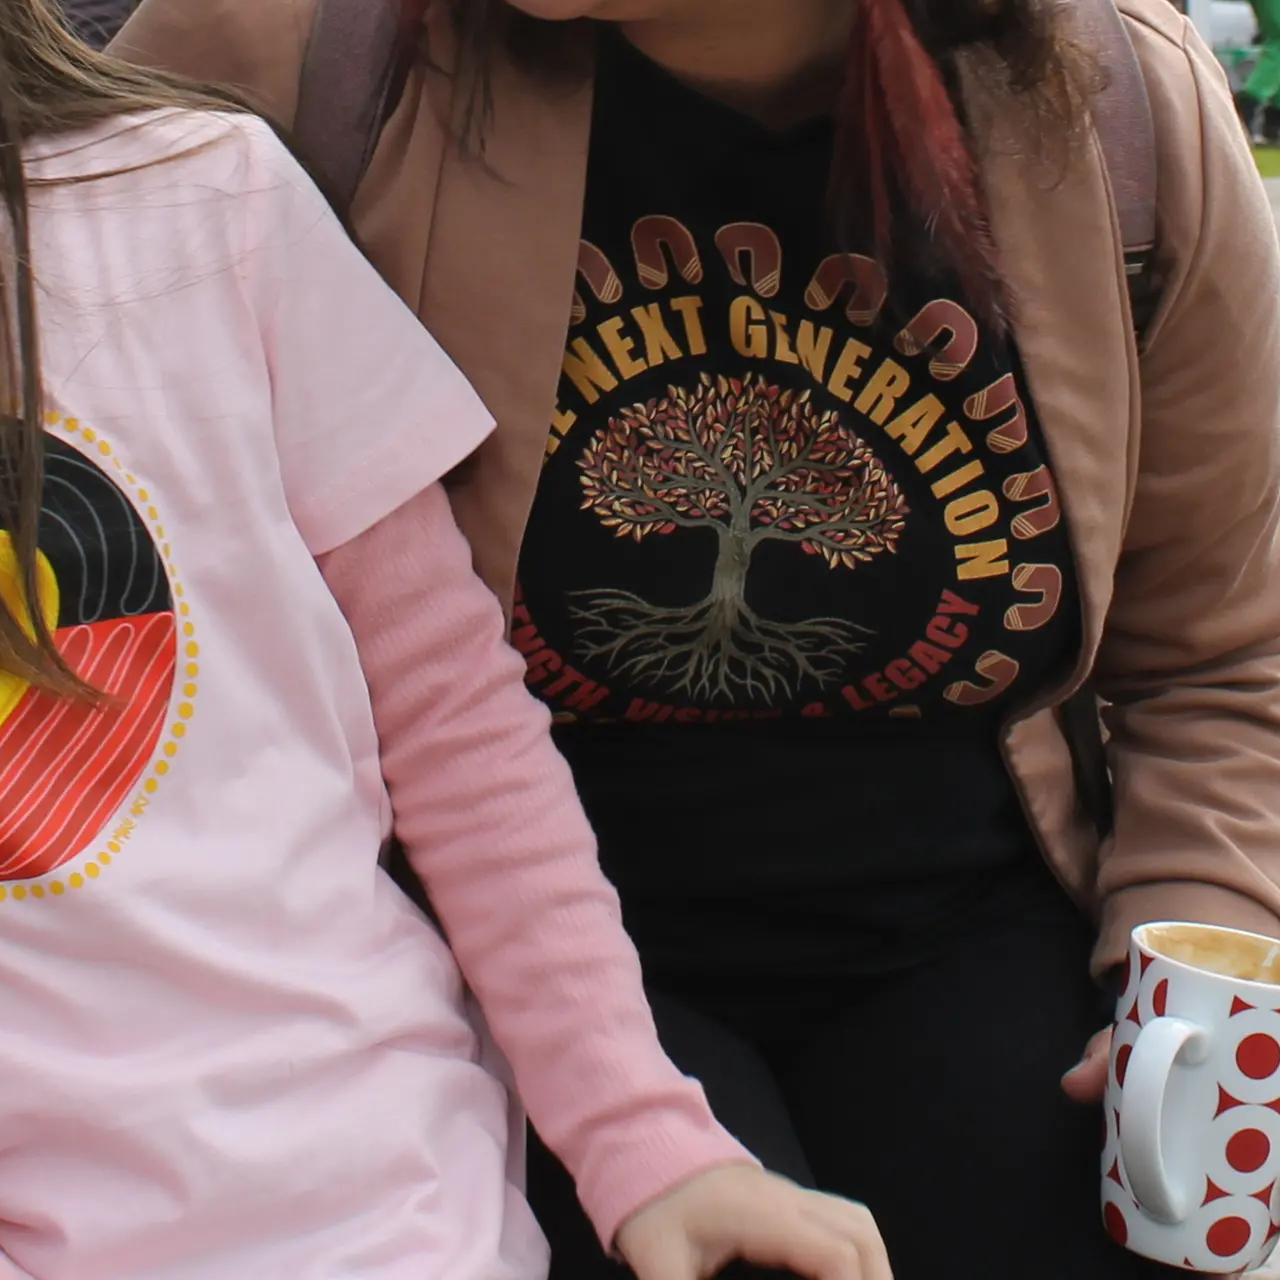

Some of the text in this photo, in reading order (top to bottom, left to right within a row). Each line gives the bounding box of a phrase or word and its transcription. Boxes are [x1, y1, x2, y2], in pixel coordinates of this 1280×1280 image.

[562, 295, 1010, 581] NEXT GENERATION
[840, 587, 981, 711] LEGACY
